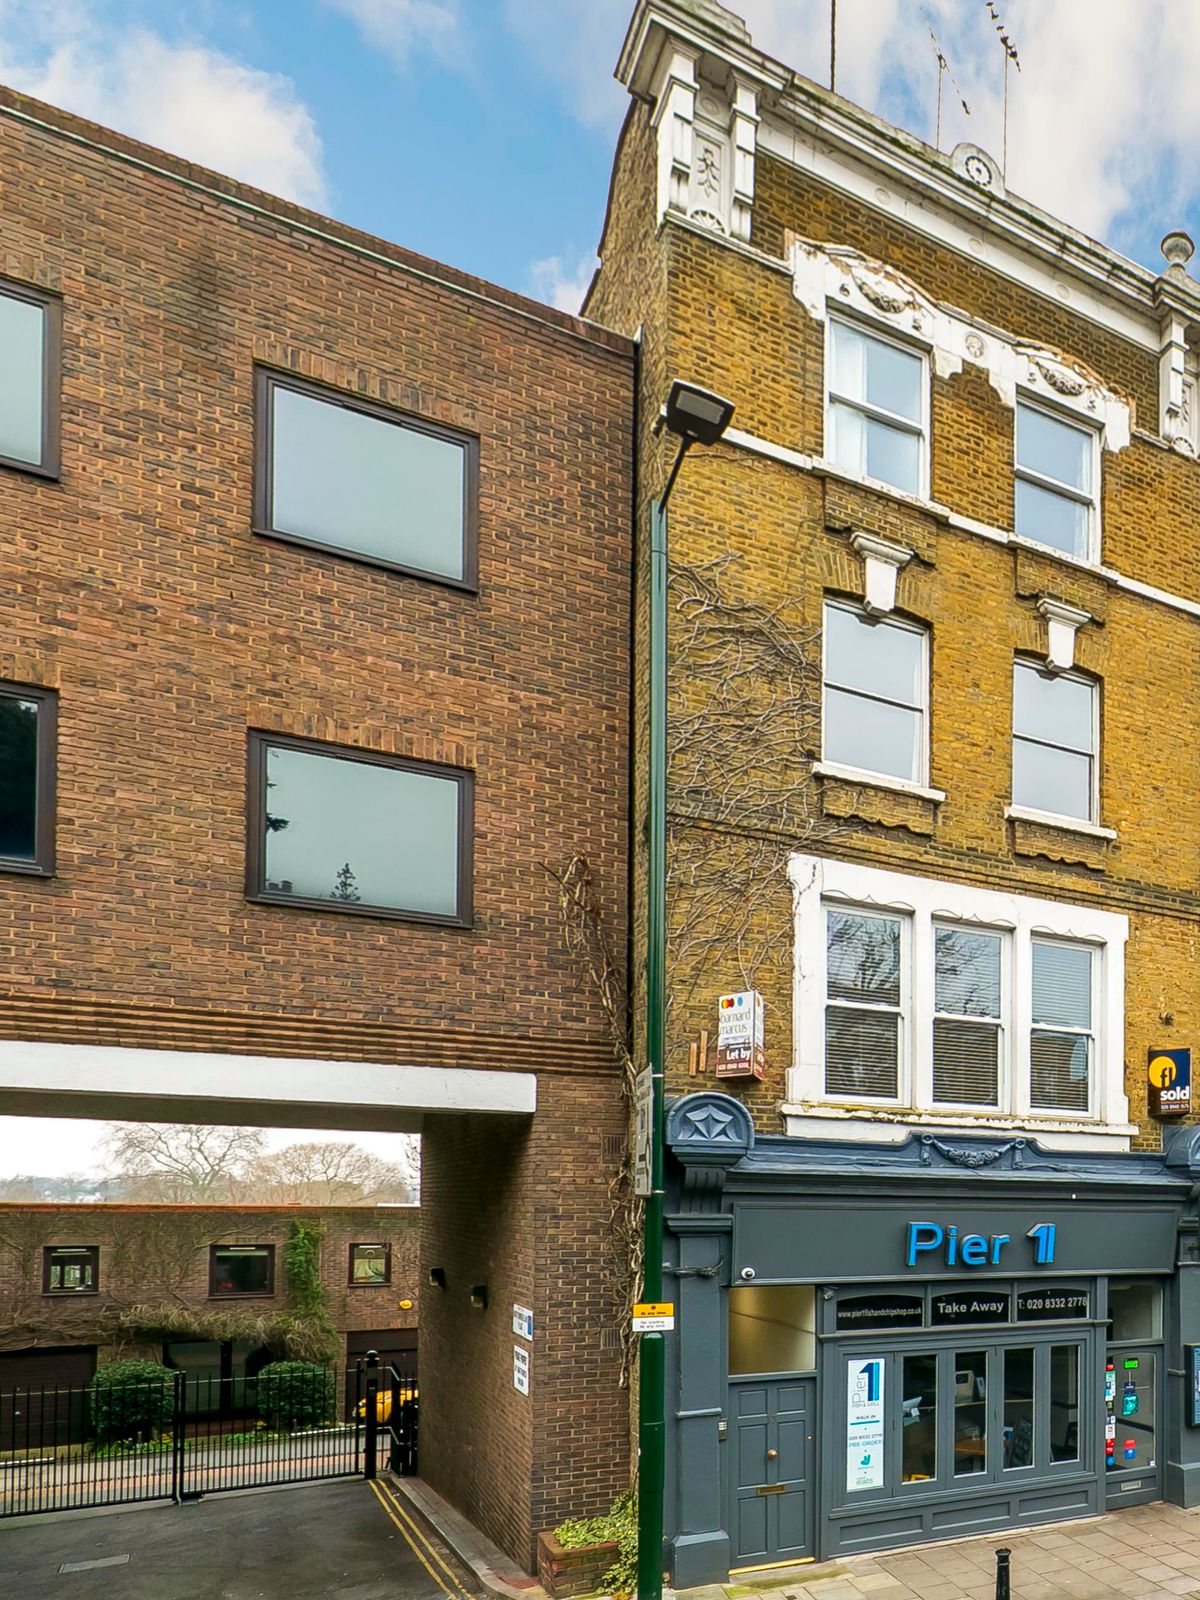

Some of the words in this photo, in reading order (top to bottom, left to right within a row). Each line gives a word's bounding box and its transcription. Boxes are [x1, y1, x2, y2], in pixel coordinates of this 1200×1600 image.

[721, 1024, 748, 1035] marcus
[726, 1049, 739, 1060] Let
[740, 1048, 751, 1060] by
[1160, 1086, 1190, 1101] sold
[907, 1221, 1012, 1266] Pier
[1026, 1223, 1057, 1264] 1
[937, 1302, 967, 1313] Take
[970, 1301, 1004, 1313] Away
[1017, 1300, 1025, 1309] T:
[1027, 1299, 1043, 1309] 020
[1045, 1298, 1065, 1309] 8332
[1067, 1296, 1087, 1307] 2778
[852, 1375, 865, 1403] Pier
[859, 1362, 880, 1401] 1
